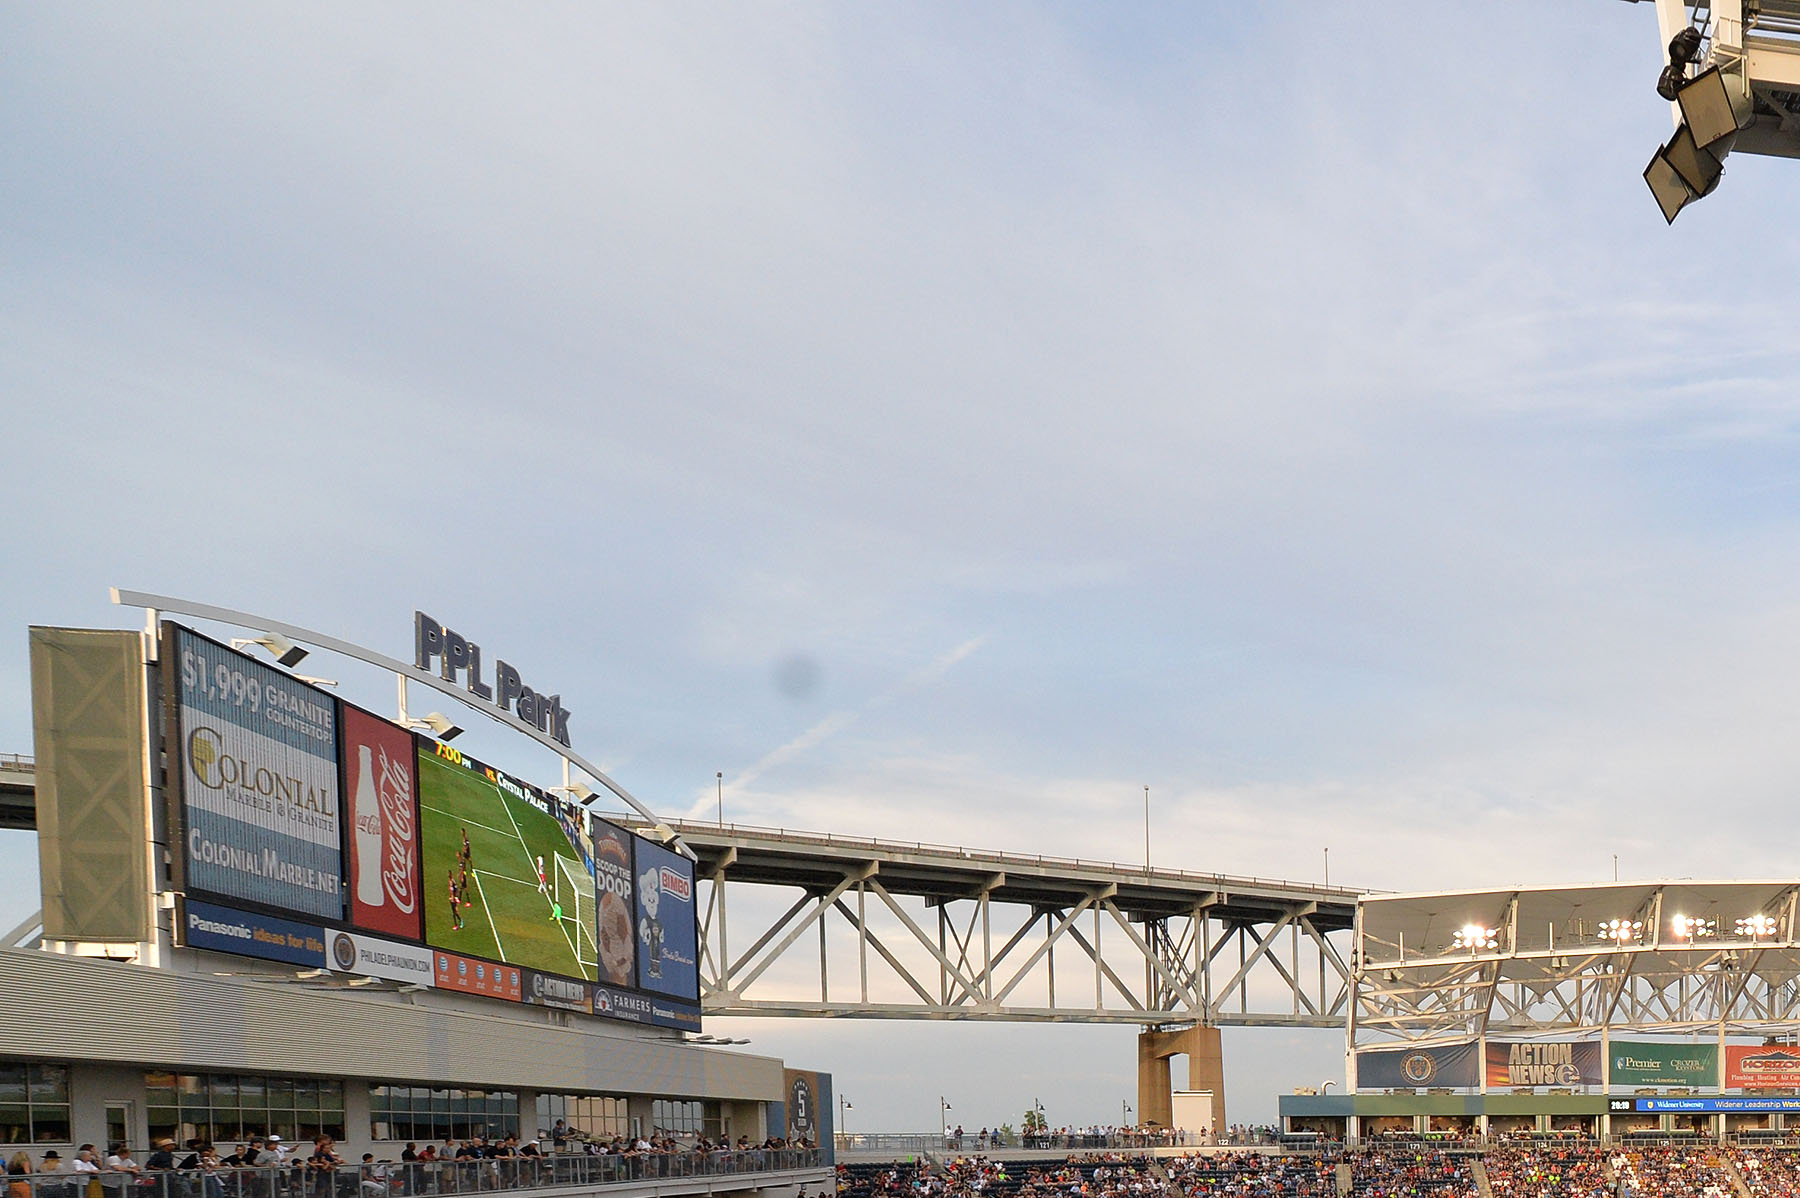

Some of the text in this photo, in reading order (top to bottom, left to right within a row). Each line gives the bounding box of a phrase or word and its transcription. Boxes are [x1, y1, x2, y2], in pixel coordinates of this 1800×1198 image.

[182, 647, 332, 729] $1,999 GRANITE
[415, 611, 572, 748] PPL Park
[435, 740, 472, 769] 7:00 PM
[189, 727, 334, 817] COLONIAL
[497, 772, 524, 800] CRYSTAL
[525, 791, 549, 813] PALACE
[226, 786, 334, 833] MARBLE & GRANITE
[596, 858, 632, 881] SCOOP THE
[597, 871, 632, 900] DOOP
[661, 872, 690, 897] BIMBO
[189, 914, 323, 952] Panasonic ideas for life
[567, 983, 585, 1001] NEWS
[614, 995, 651, 1012] FARMERS
[1509, 1043, 1572, 1065] ACTION
[1626, 1057, 1661, 1068] Premier
[1509, 1065, 1556, 1084] NEWS
[798, 1089, 806, 1117] 5
[1680, 1101, 1704, 1110] University
[1745, 1102, 1781, 1110] Leadership
